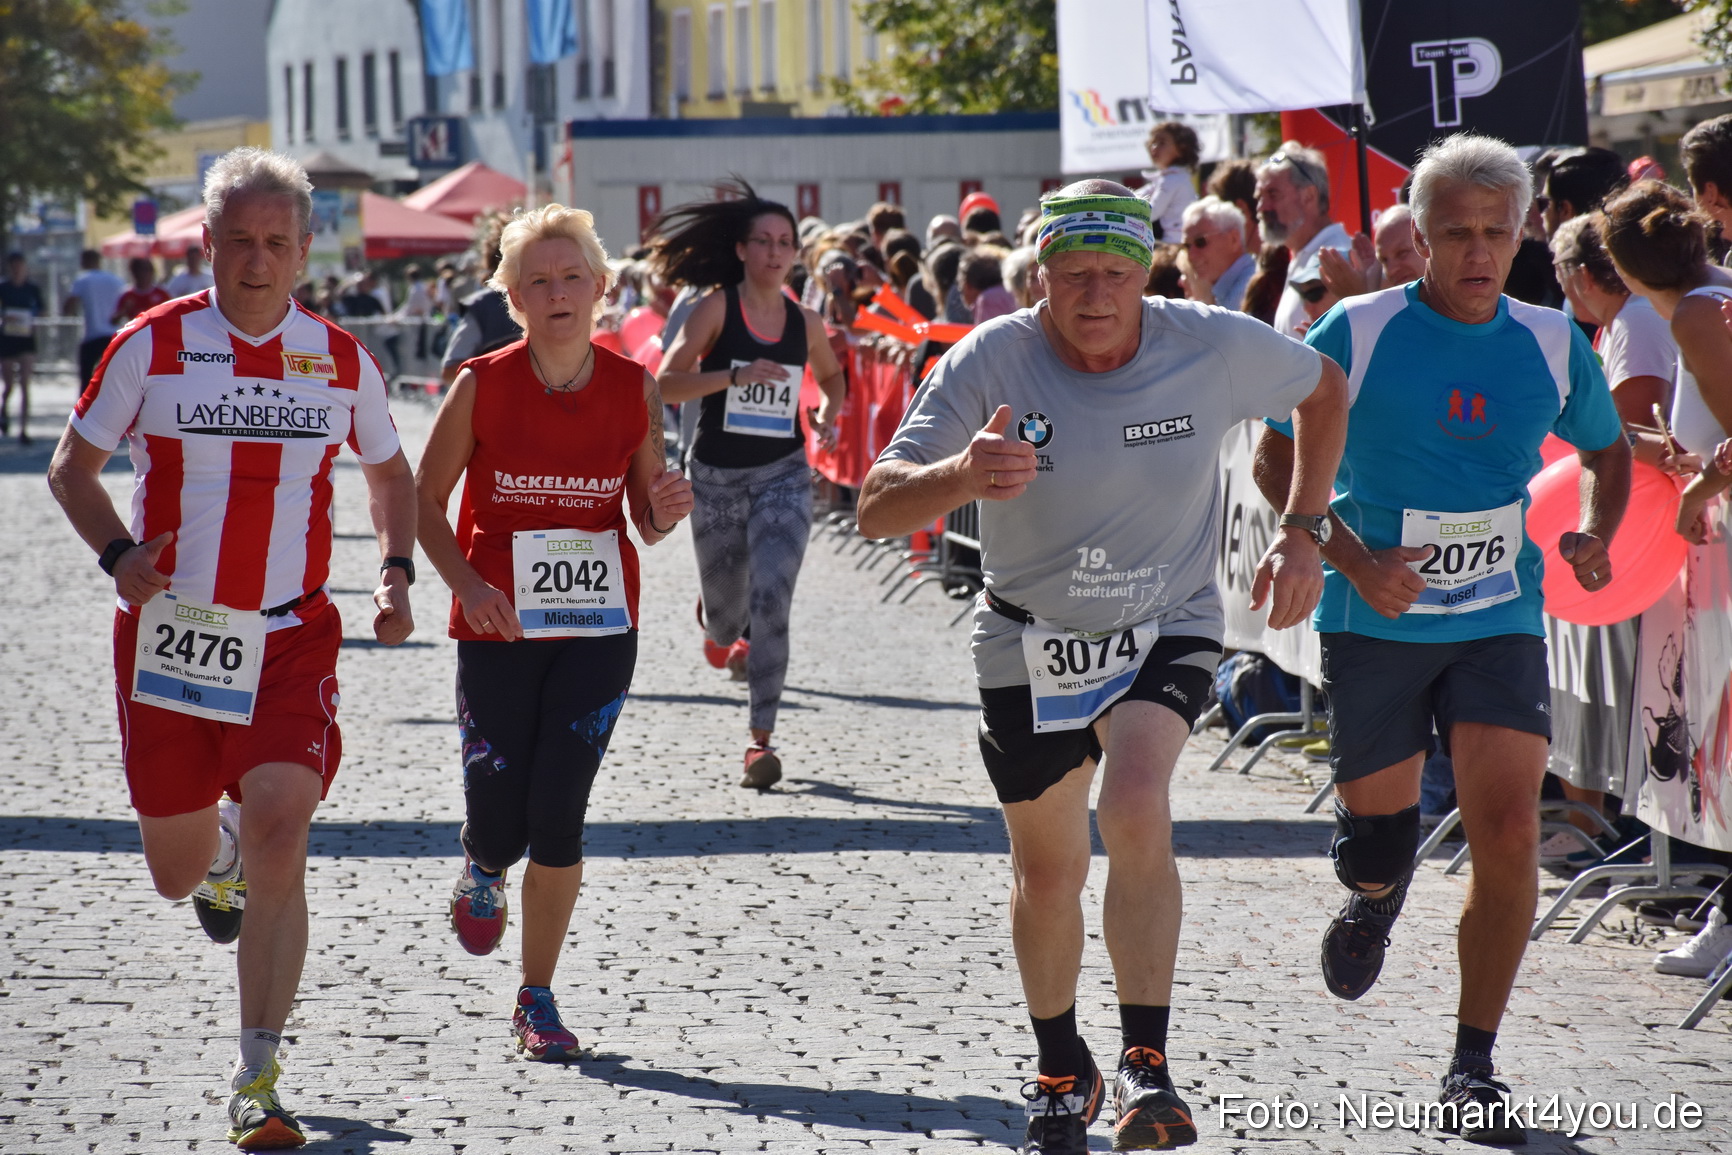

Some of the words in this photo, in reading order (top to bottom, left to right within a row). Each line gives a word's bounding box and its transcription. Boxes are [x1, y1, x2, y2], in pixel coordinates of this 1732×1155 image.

[1418, 49, 1445, 59] Team
[177, 350, 236, 364] macron
[313, 362, 335, 374] UNION
[738, 382, 791, 407] 3014
[222, 428, 293, 437] NEWTRITIONSTYLE
[1123, 414, 1194, 442] BOCK
[1124, 440, 1148, 448] inspired
[1157, 435, 1173, 444] smart
[1174, 431, 1196, 441] concepts
[492, 493, 547, 506] HAUSHALT
[558, 496, 595, 509] KÜCHE
[1439, 519, 1493, 535] BOCK
[547, 540, 594, 551] BOCK
[1077, 546, 1113, 570] 19.
[1419, 535, 1506, 575] 2076
[531, 560, 610, 594] 2042
[1426, 577, 1453, 586] PARTL
[1454, 571, 1485, 585] Neumarkt
[1067, 583, 1136, 599] Stadtlauf
[1441, 584, 1478, 604] Josef
[566, 597, 597, 605] Neumarkt
[175, 604, 229, 625] BOCK
[544, 612, 604, 626] Michaela
[143, 645, 149, 653] C
[155, 623, 243, 672] 2476
[1043, 628, 1139, 677] 3074
[160, 663, 184, 676] PARTL
[184, 670, 221, 683] Neumarkt
[1036, 669, 1042, 677] C
[182, 684, 202, 702] Ivo
[1058, 682, 1083, 690] PARTL
